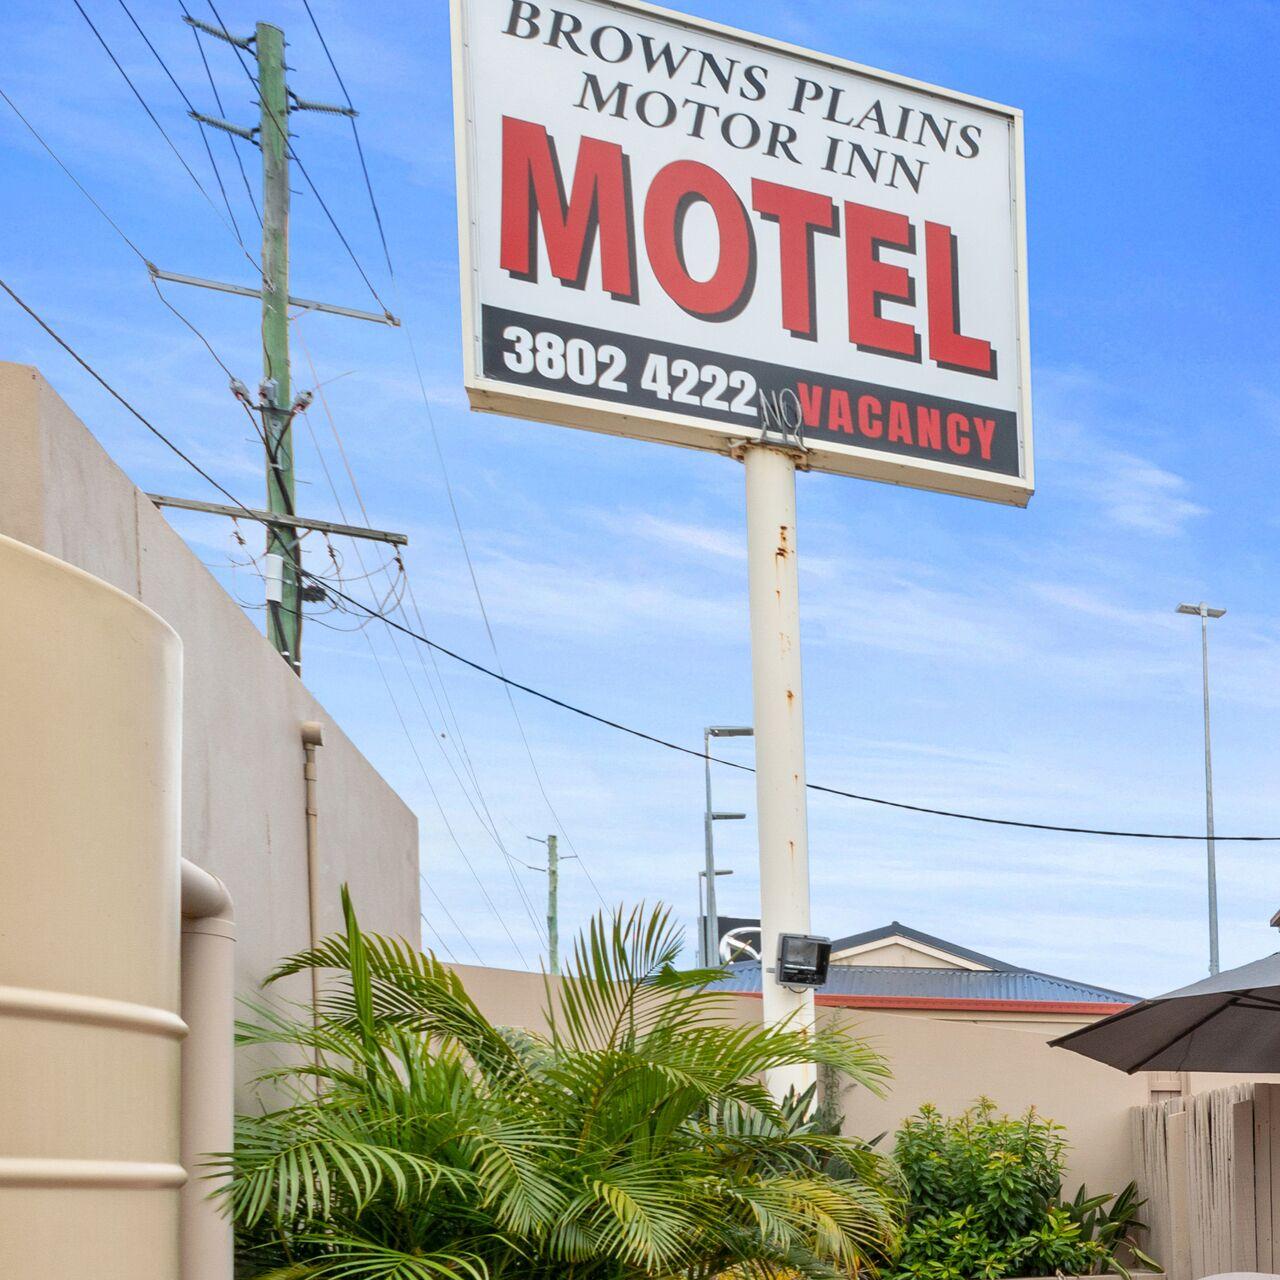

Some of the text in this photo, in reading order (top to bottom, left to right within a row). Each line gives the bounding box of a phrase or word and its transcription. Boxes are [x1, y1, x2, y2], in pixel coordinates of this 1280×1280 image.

[501, 0, 982, 160] BROWNS PLAINS
[573, 71, 930, 194] MOTOR INN
[500, 114, 998, 381] MOTEL
[503, 326, 758, 417] 3802 4222
[797, 382, 996, 461] VACANCY
